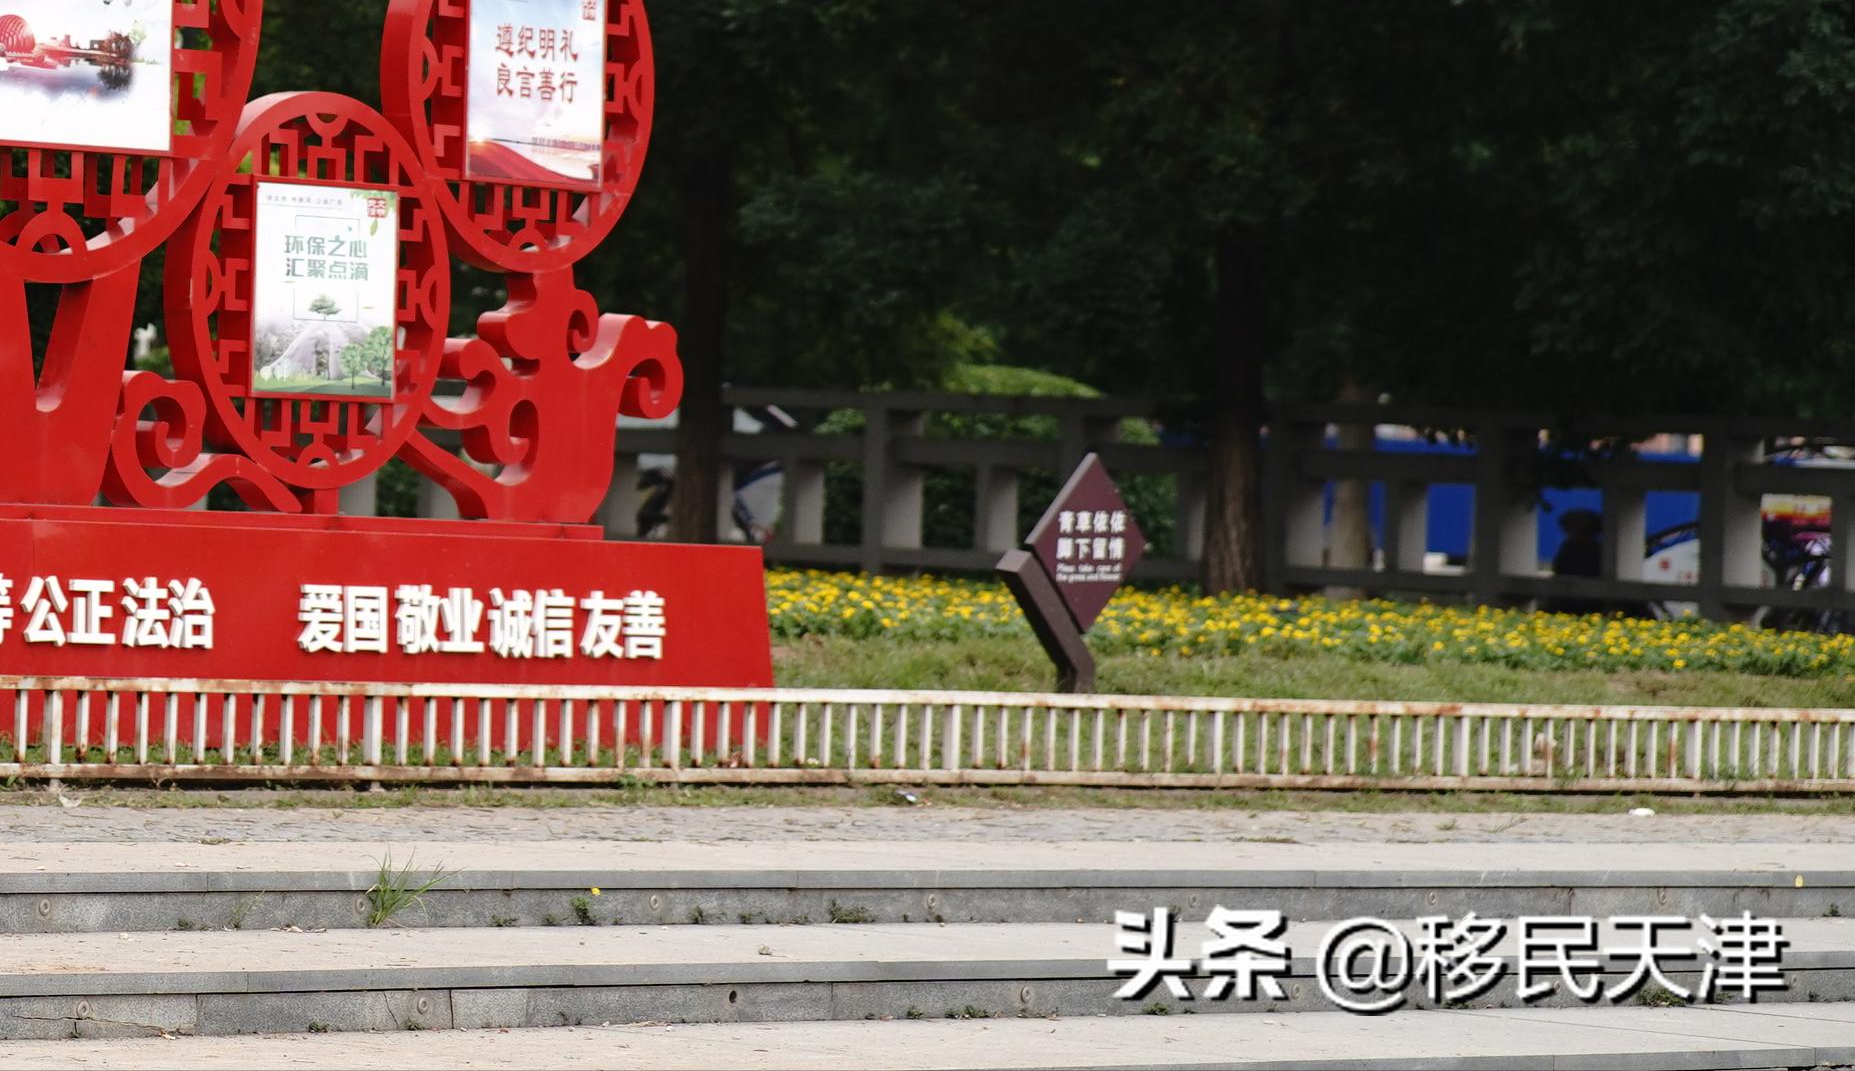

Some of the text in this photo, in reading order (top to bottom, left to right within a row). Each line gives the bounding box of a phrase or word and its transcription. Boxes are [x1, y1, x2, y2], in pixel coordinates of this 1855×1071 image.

[495, 22, 578, 61] 遵纪明礼
[496, 63, 578, 103] 良言善行
[284, 234, 368, 259] 环保之心
[285, 257, 369, 281] 汇聚点滴
[297, 584, 666, 660] 爱国敬业诚信友善
